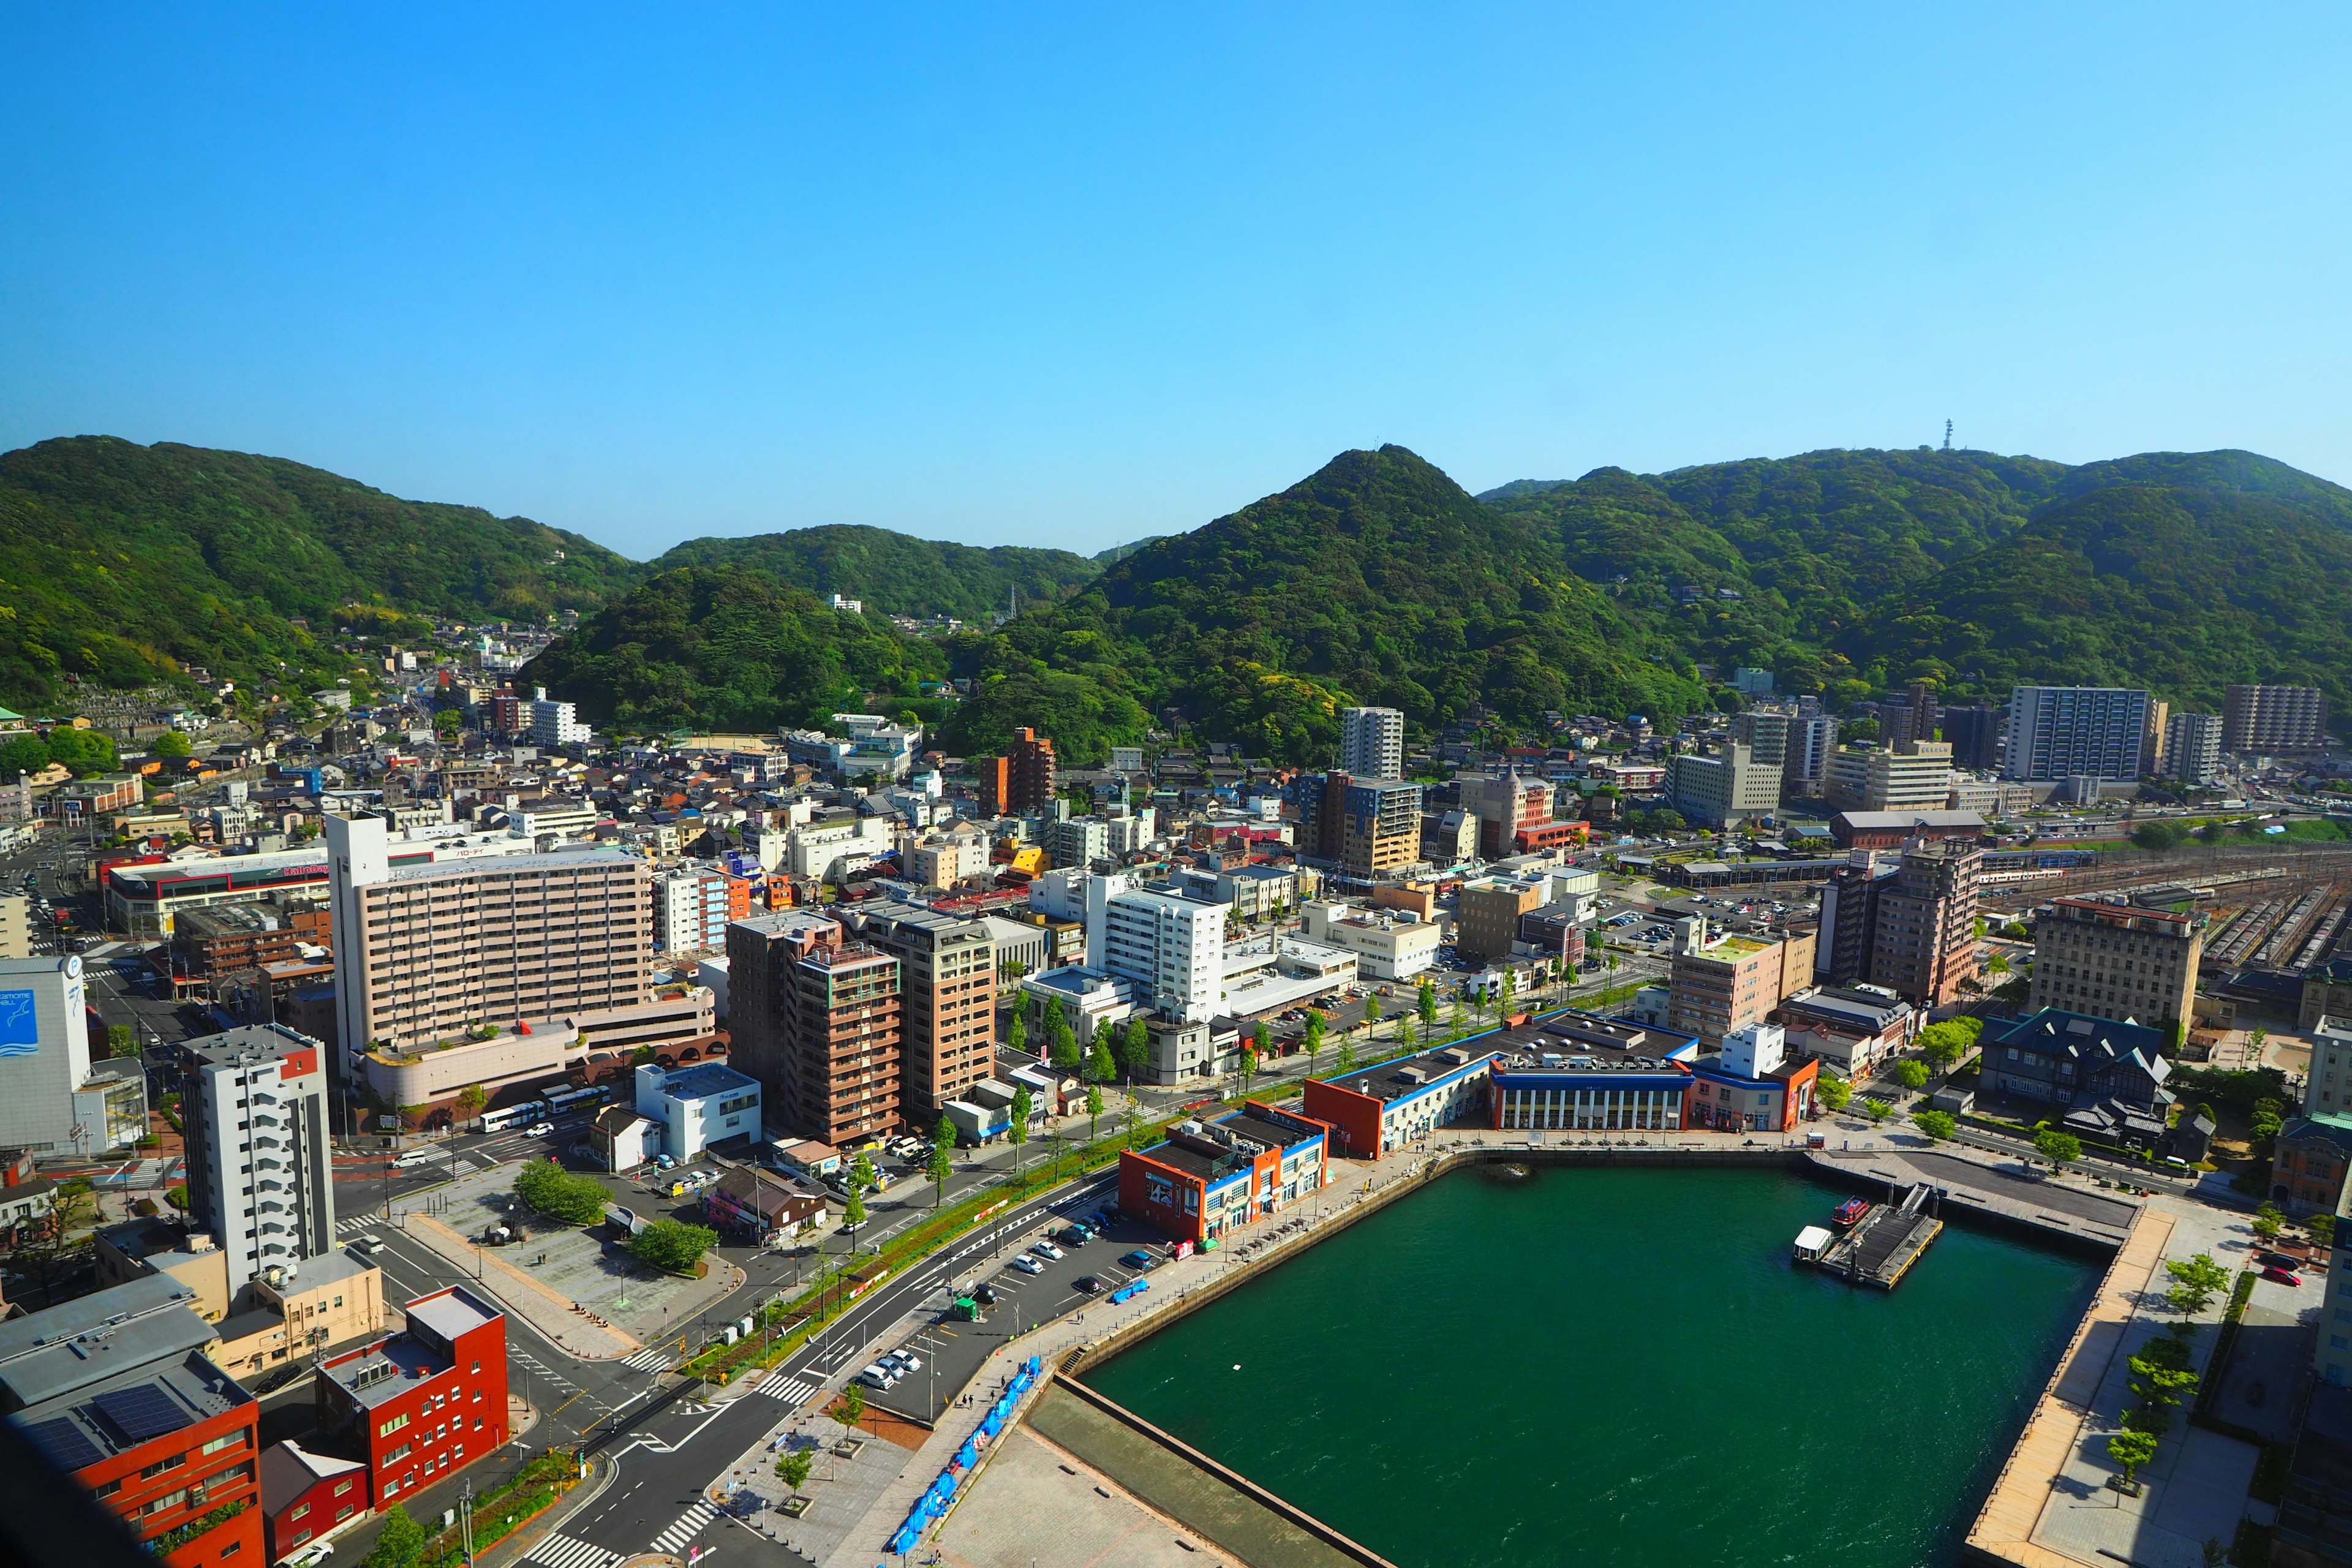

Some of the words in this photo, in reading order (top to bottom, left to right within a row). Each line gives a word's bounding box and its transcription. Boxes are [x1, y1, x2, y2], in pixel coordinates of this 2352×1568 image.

[456, 848, 484, 856] ハローデイ
[284, 864, 329, 875] HalloDay
[71, 959, 78, 973] P
